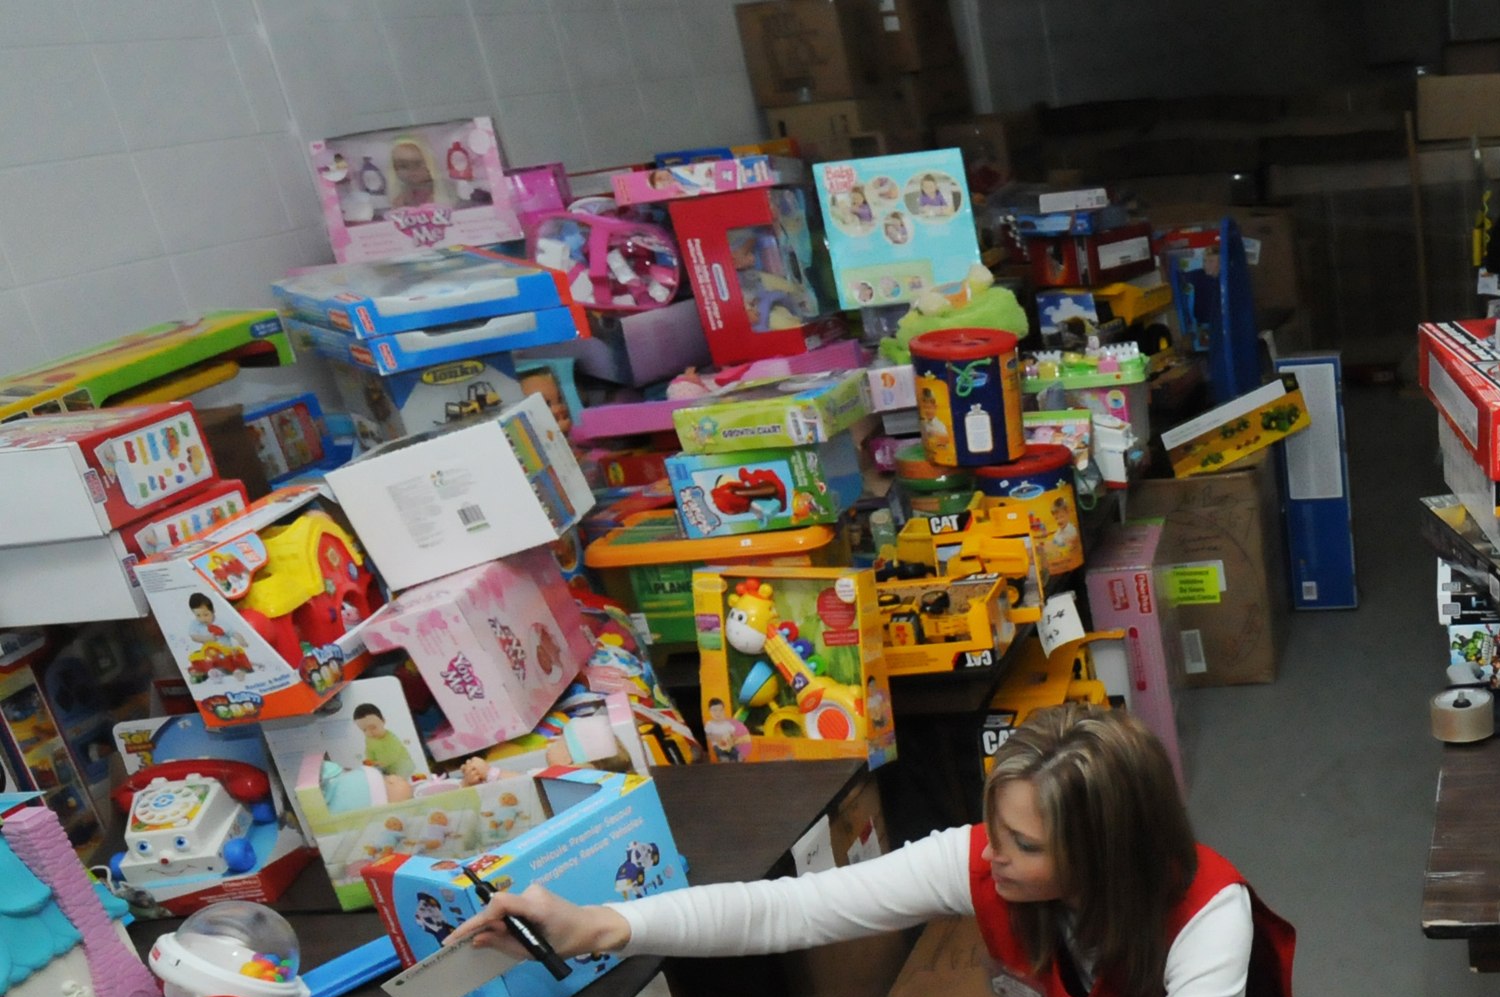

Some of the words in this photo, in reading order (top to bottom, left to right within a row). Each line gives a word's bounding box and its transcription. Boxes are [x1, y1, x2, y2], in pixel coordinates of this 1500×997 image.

[930, 514, 959, 534] CAT
[965, 650, 993, 668] CAT
[982, 729, 1017, 755] CA
